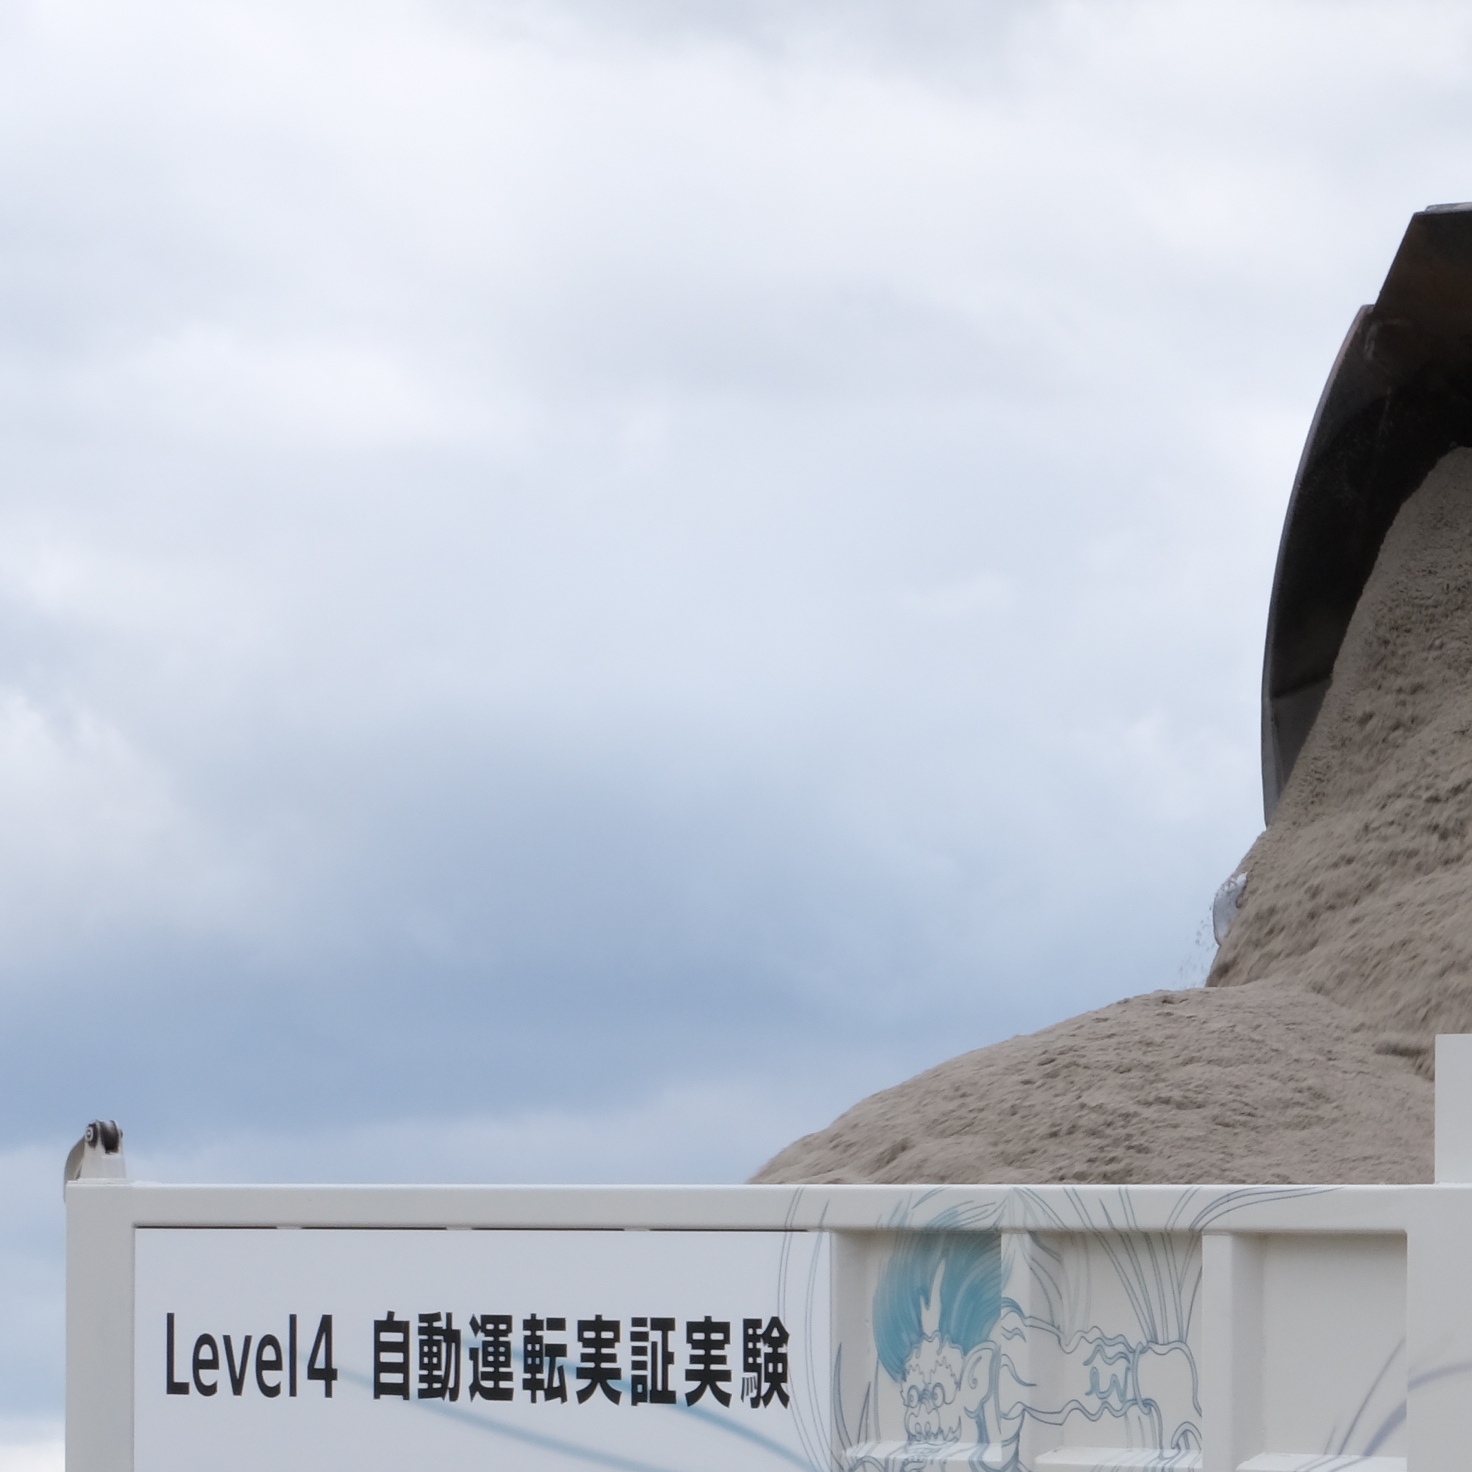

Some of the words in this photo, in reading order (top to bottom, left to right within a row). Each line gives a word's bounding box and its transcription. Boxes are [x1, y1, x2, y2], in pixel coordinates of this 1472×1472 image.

[165, 1311, 339, 1399] Level4
[372, 1311, 791, 1409] 自動運転実証実験
